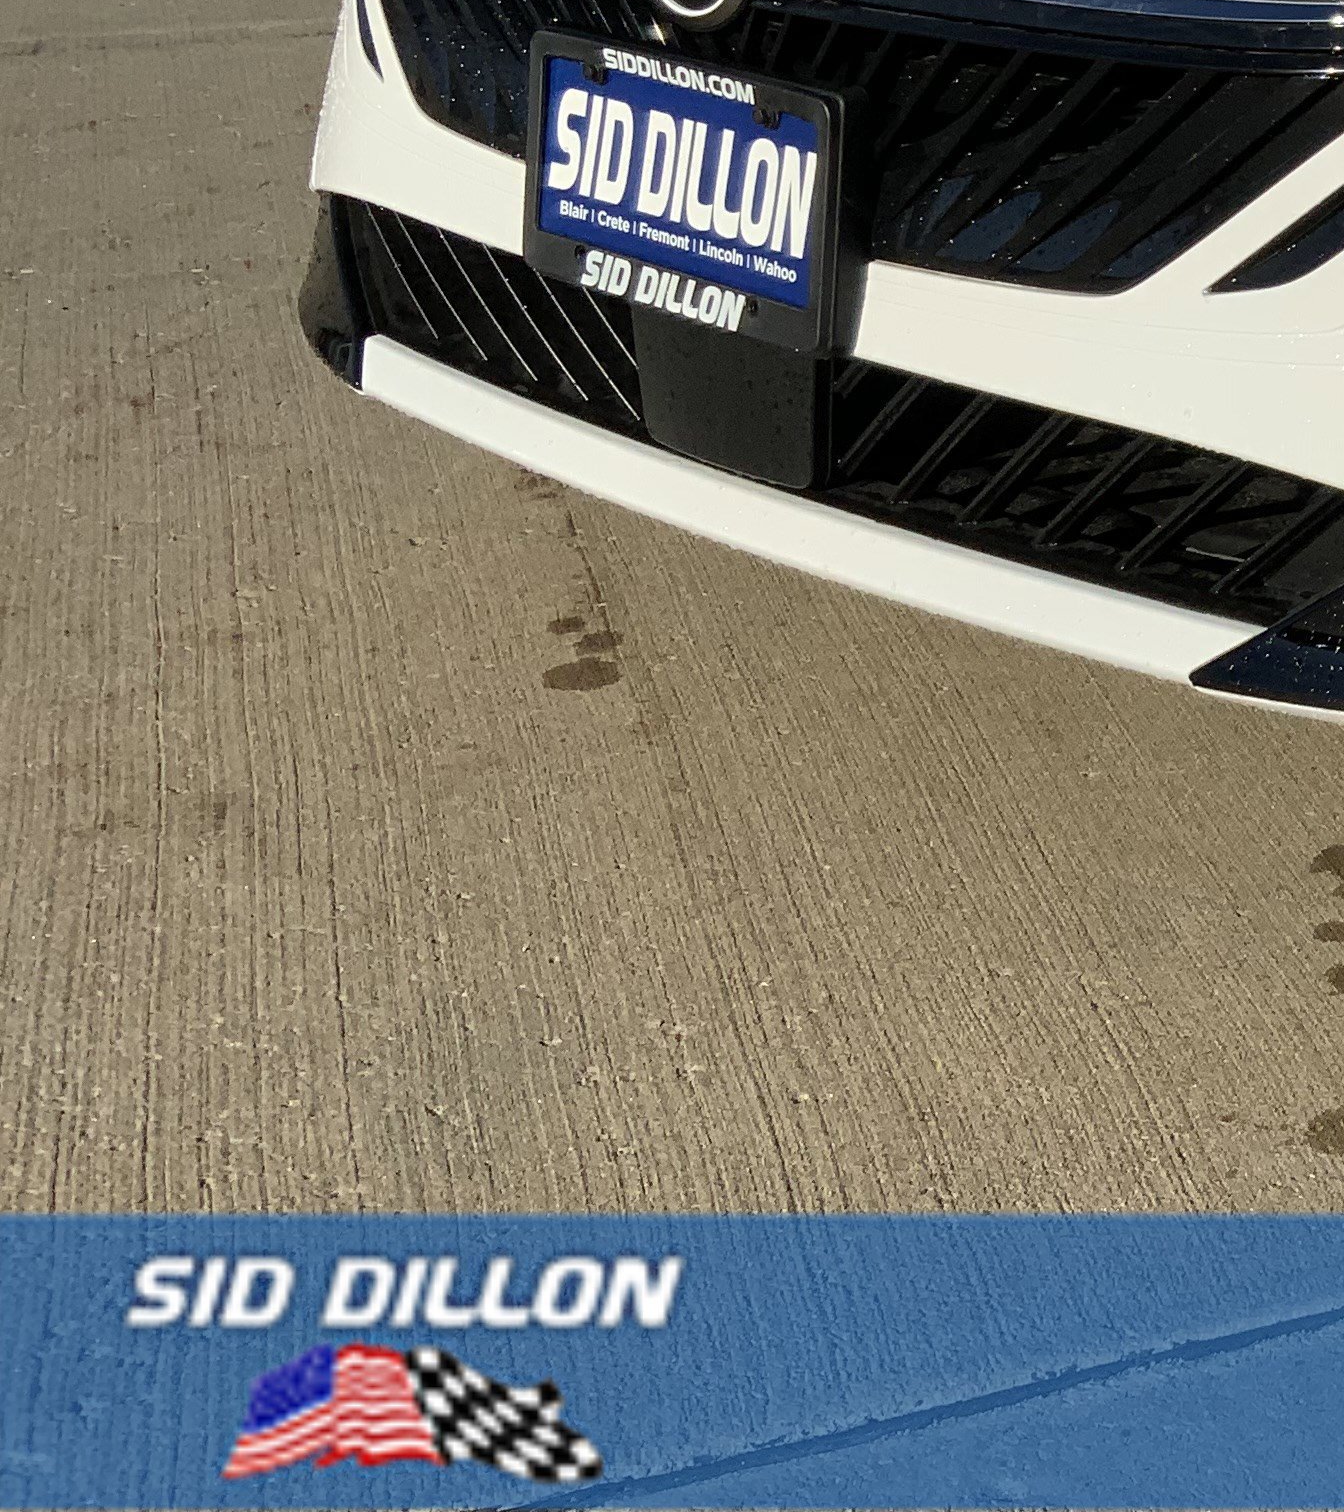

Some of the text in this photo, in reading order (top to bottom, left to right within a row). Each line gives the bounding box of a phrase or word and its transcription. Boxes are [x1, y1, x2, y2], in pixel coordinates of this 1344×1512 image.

[602, 48, 755, 105] SIDDILLON.COM
[548, 88, 817, 259] SID DILLON
[559, 200, 797, 283] Blair Crete Fremont Lincoln Wahoo
[581, 250, 746, 332] SID DILLON
